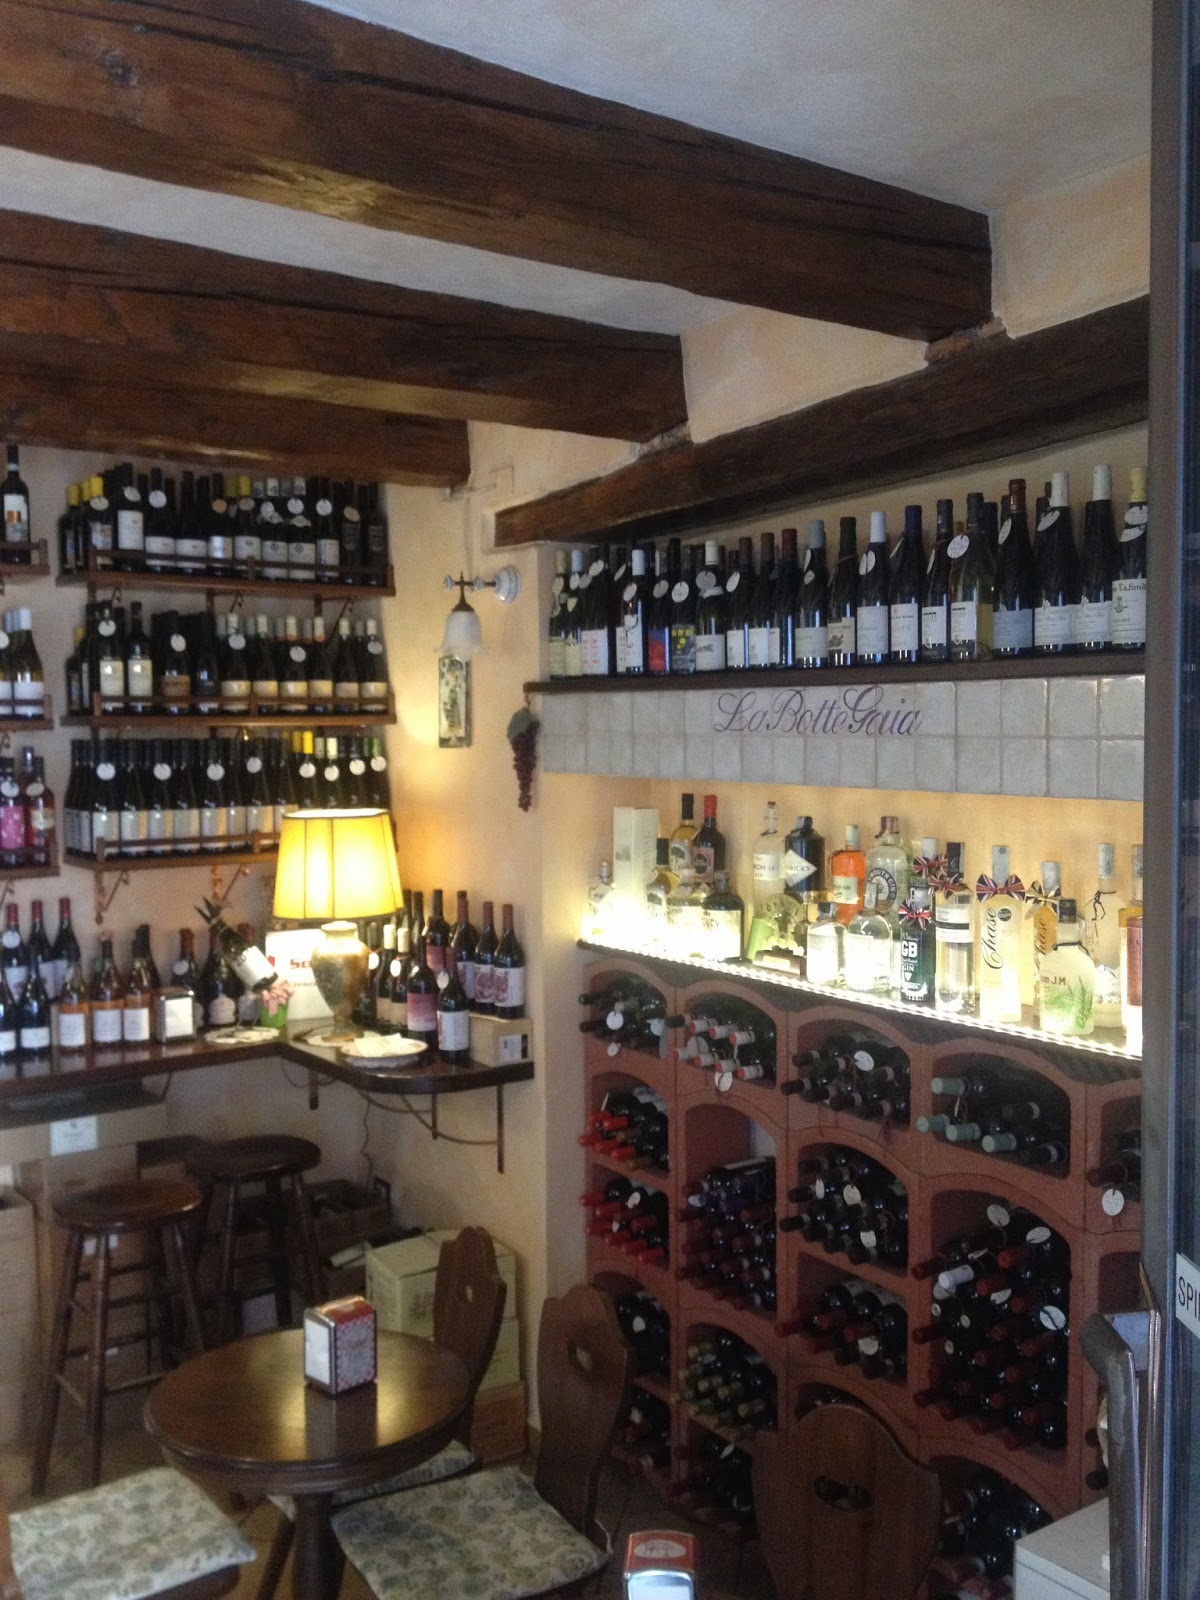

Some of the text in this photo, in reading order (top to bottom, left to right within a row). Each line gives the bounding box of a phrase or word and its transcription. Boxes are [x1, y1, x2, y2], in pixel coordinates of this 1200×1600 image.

[714, 690, 769, 733] La
[765, 688, 846, 735] Botte
[901, 940, 918, 958] GB
[982, 907, 1004, 970] Chase
[1178, 1276, 1200, 1322] SPI
